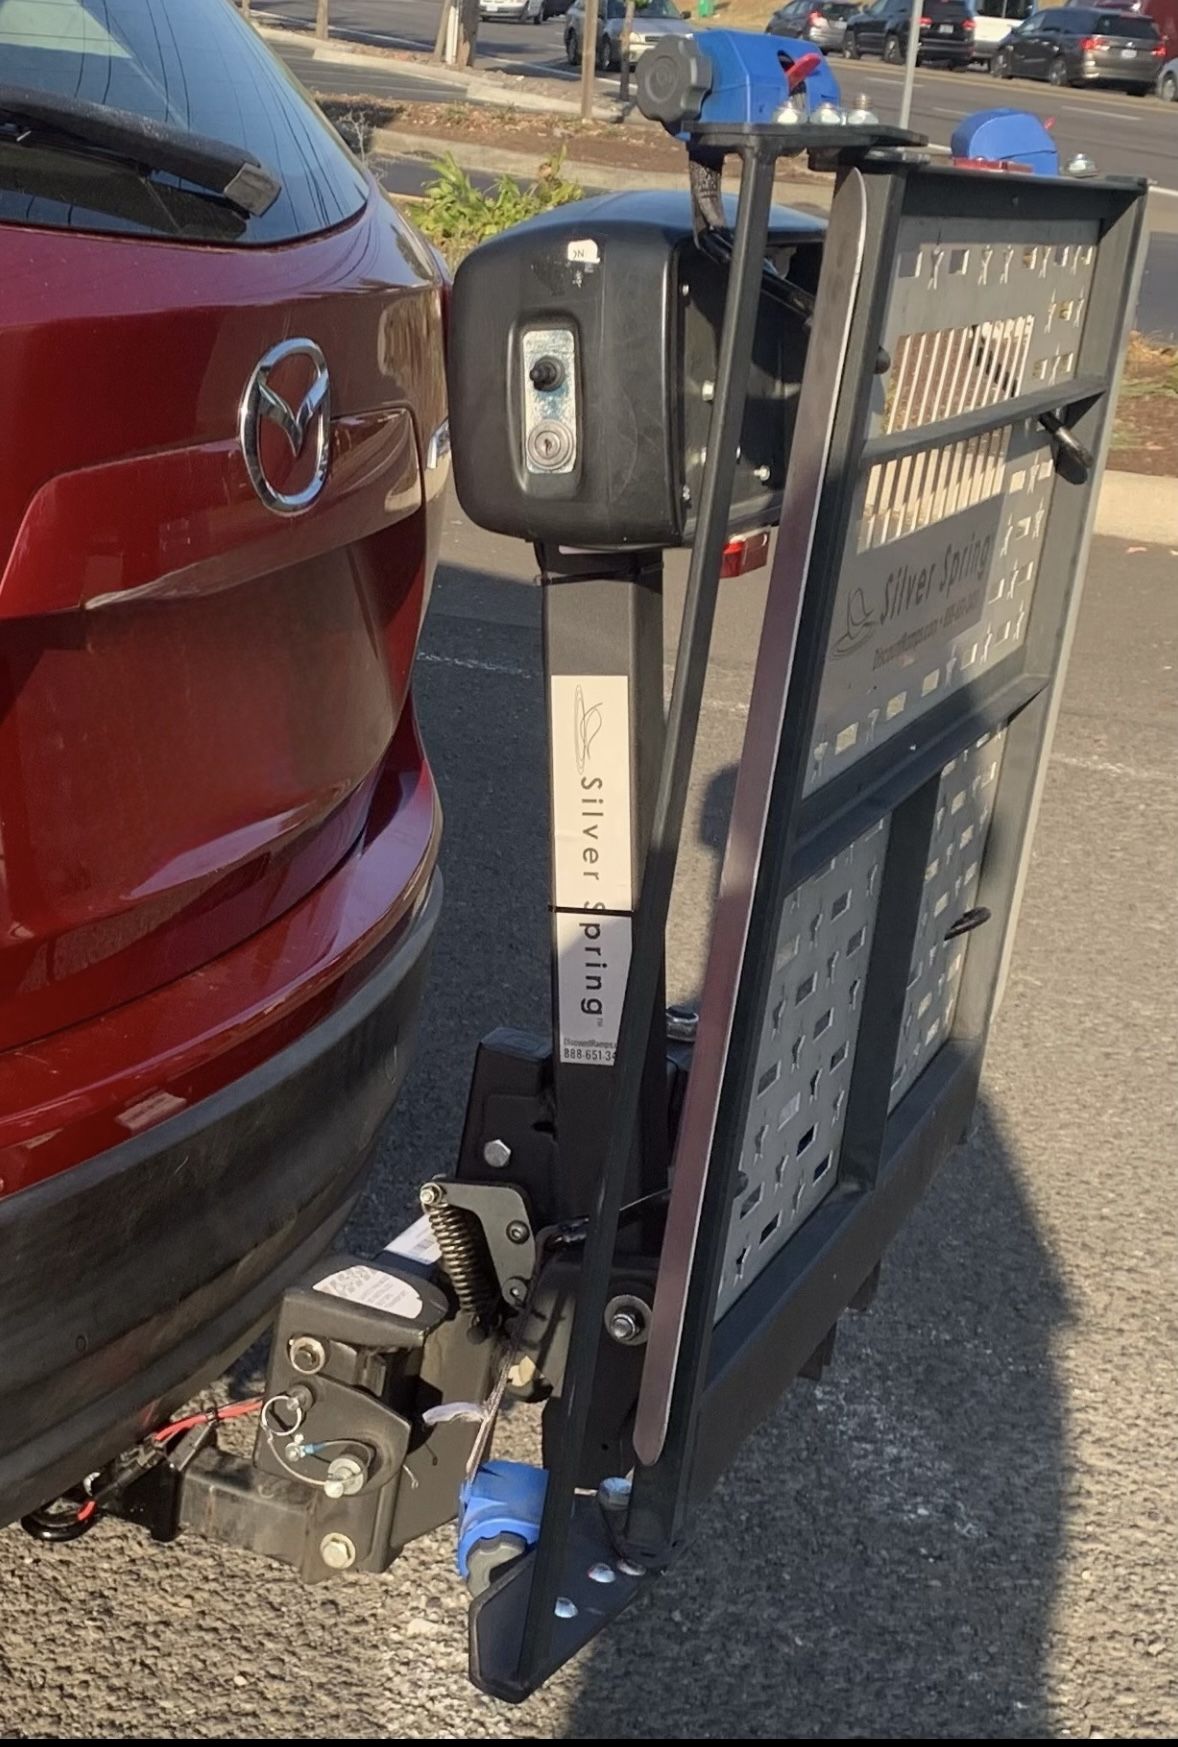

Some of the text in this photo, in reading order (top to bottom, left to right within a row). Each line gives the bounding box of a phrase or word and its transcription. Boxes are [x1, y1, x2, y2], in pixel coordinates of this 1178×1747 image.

[879, 563, 936, 626] Silver
[939, 531, 991, 600] Spring
[581, 776, 604, 881] Silver
